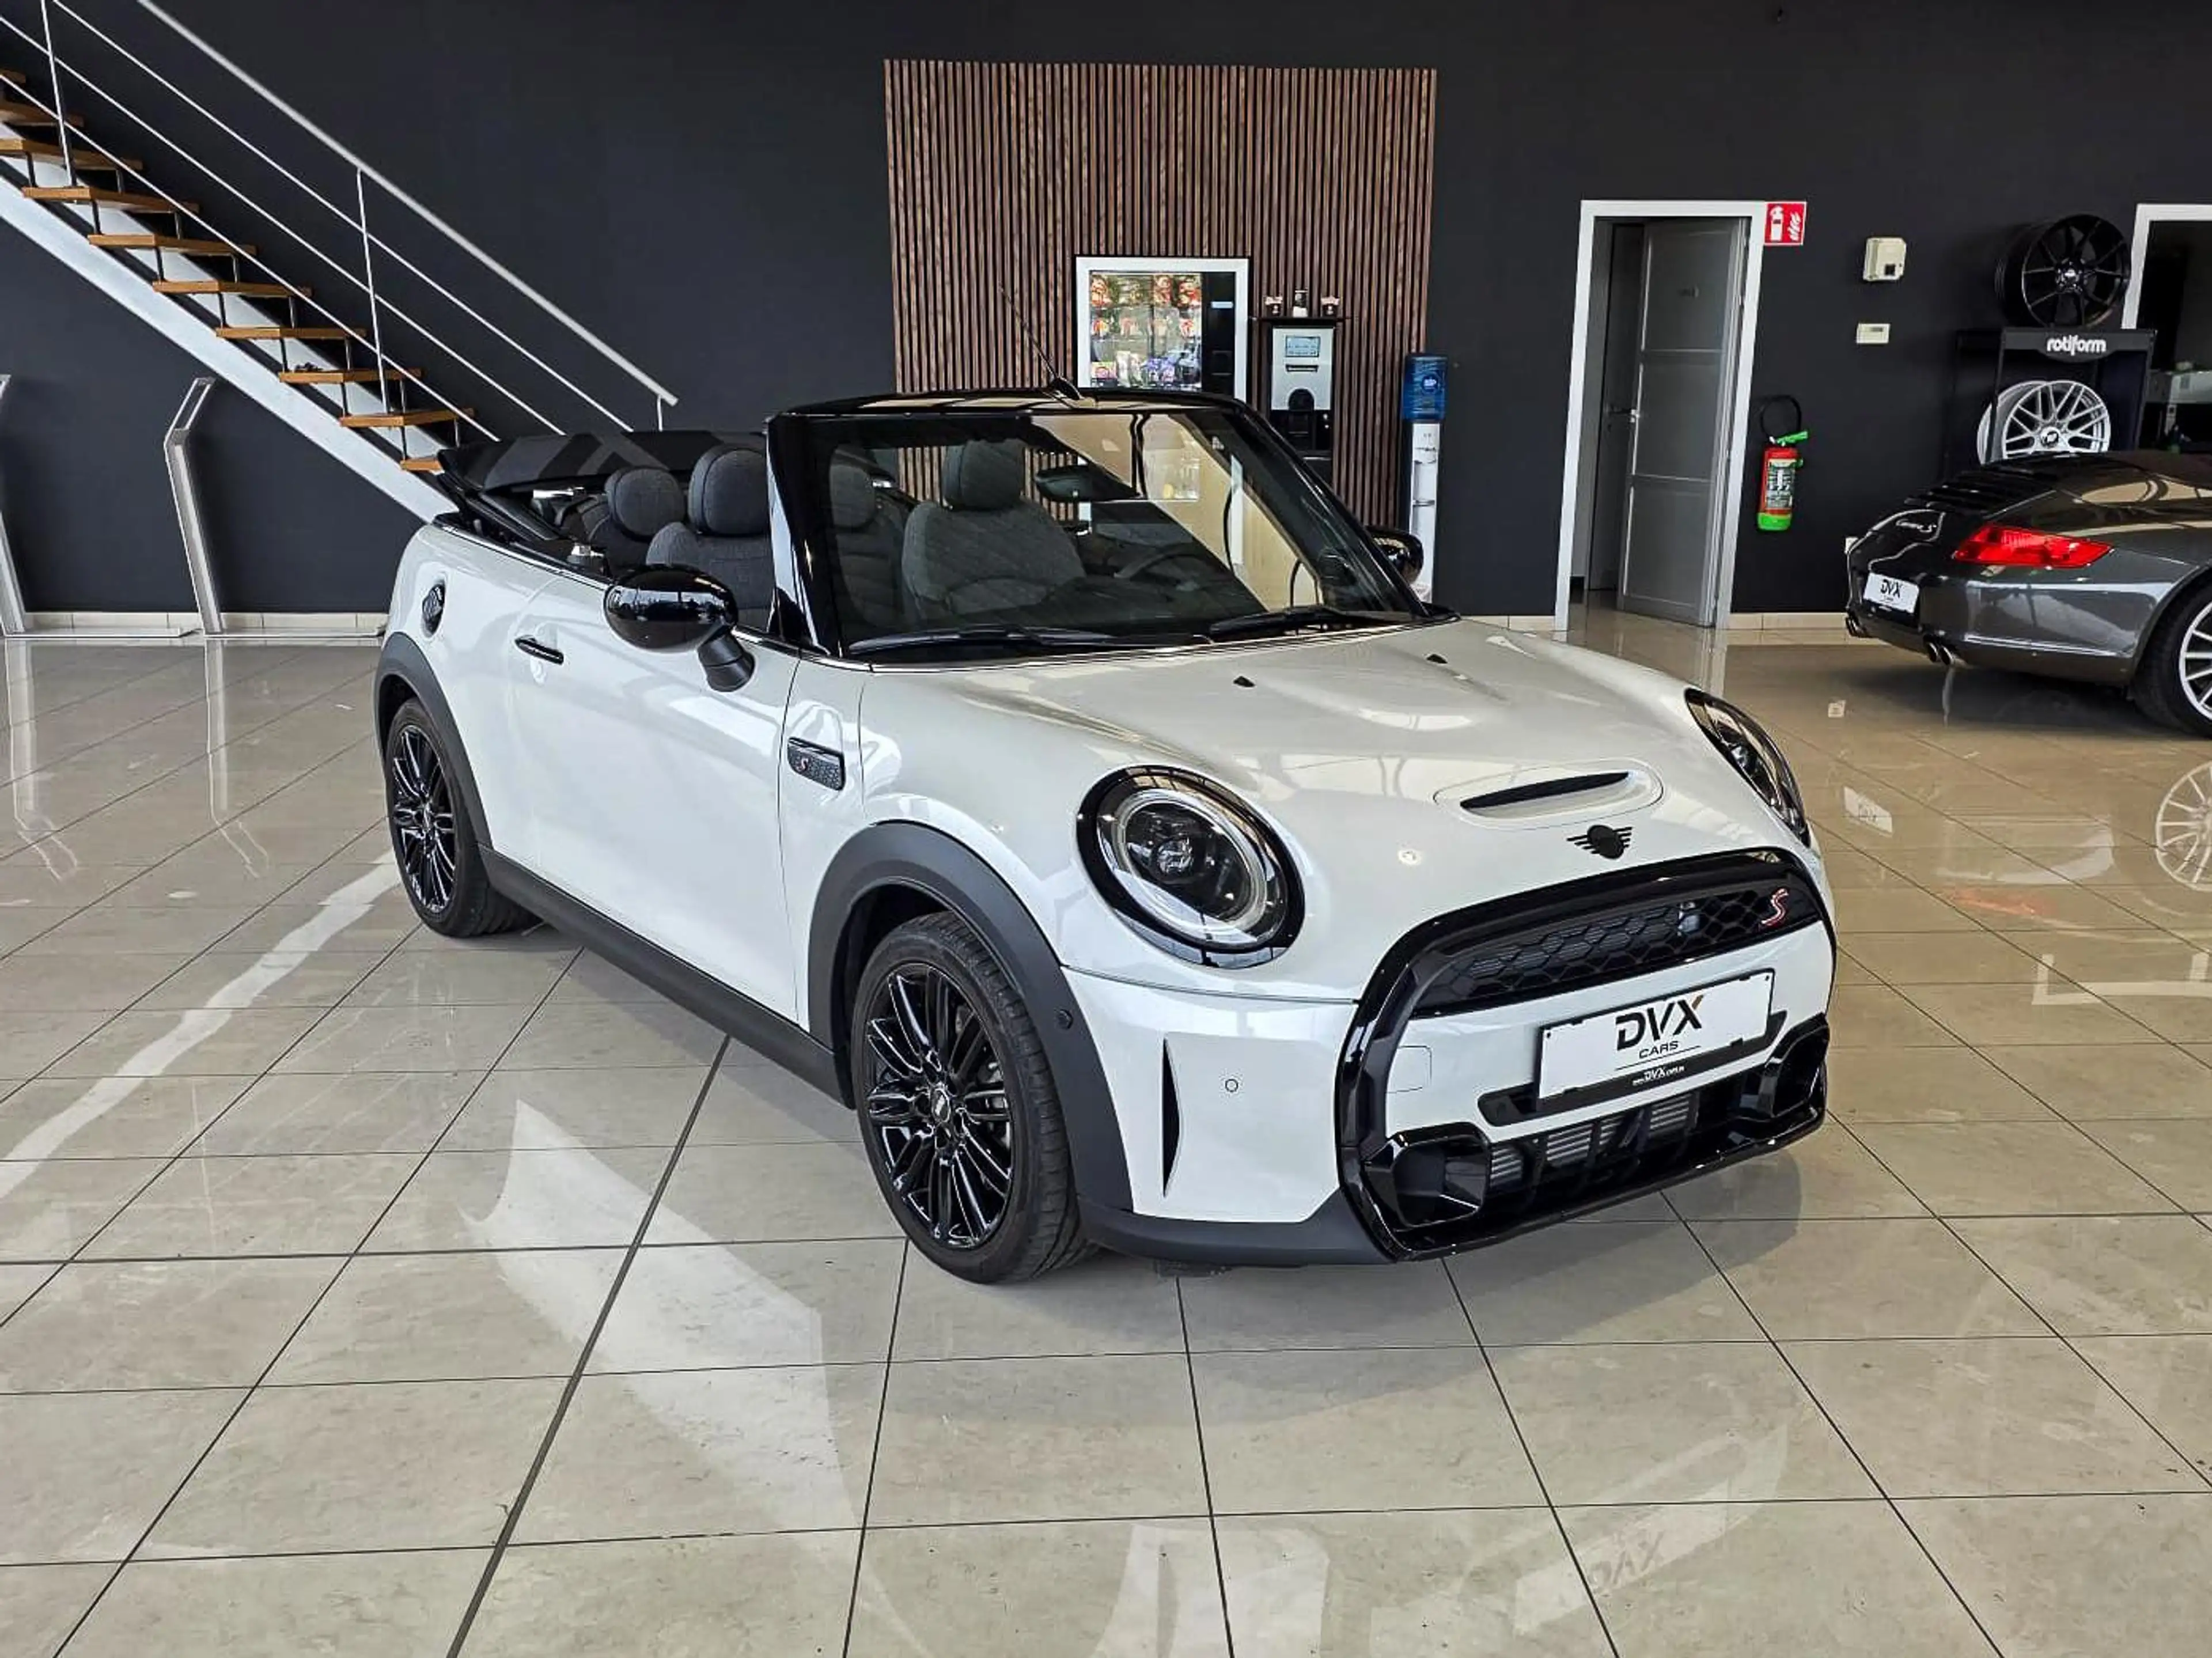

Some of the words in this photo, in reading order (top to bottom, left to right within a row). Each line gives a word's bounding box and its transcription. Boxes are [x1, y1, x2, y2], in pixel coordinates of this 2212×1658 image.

[2047, 335, 2107, 356] rotiform
[1880, 579, 1902, 598] DVX
[1761, 888, 1789, 927] S
[1615, 995, 1703, 1051] DVX
[1639, 1040, 1679, 1059] CARS
